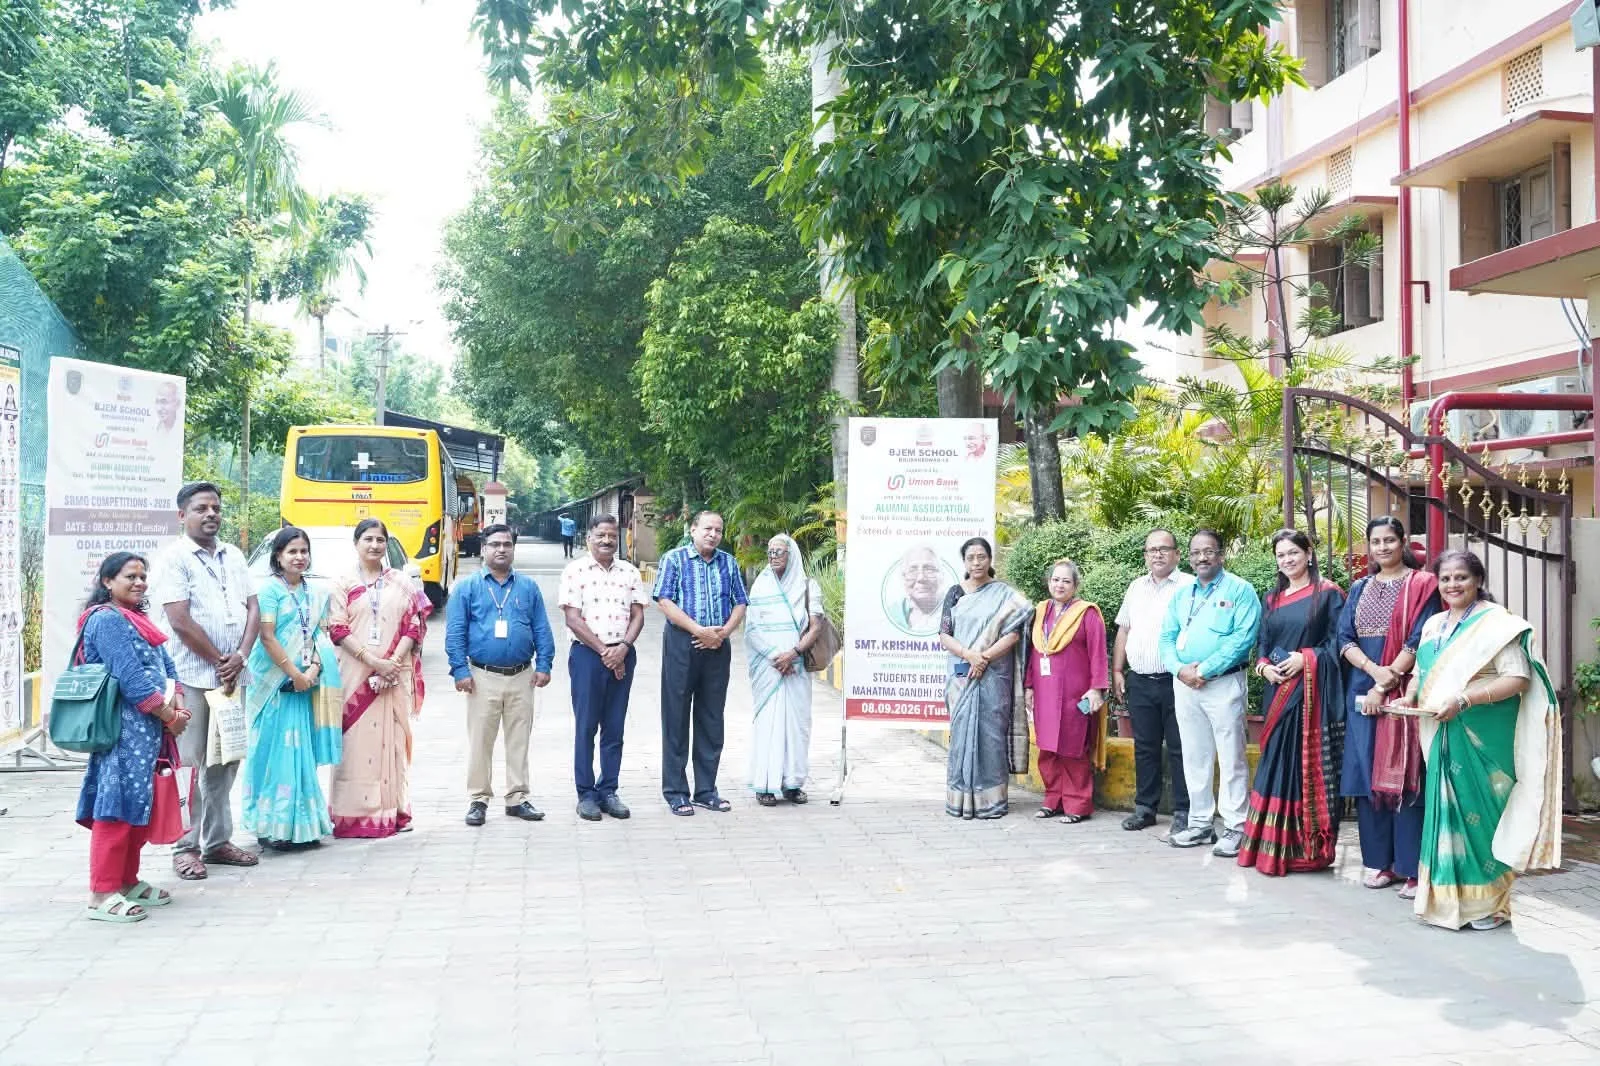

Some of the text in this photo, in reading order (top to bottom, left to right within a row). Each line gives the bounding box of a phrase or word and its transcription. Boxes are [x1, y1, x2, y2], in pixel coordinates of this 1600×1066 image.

[120, 406, 152, 417] SCHOOL
[888, 448, 959, 457] BJEM SCHOOL
[908, 477, 959, 486] Union Bank
[91, 496, 148, 508] COMPETITIONS
[875, 503, 970, 514] ALUMNI ASSOCIATION
[65, 520, 86, 532] DATE
[134, 522, 169, 535] (Tuesday)
[856, 525, 892, 536] Extends
[935, 527, 975, 536] welcome
[76, 539, 159, 550] ODIA ELOCUTION
[854, 639, 880, 650] SMT.
[882, 640, 929, 651] KRISHNA
[872, 672, 947, 684] STUDENTS REME
[852, 685, 896, 697] MAHATMA
[898, 687, 932, 698] GANDHI
[861, 702, 948, 717] 08.09.2026 (Tue
